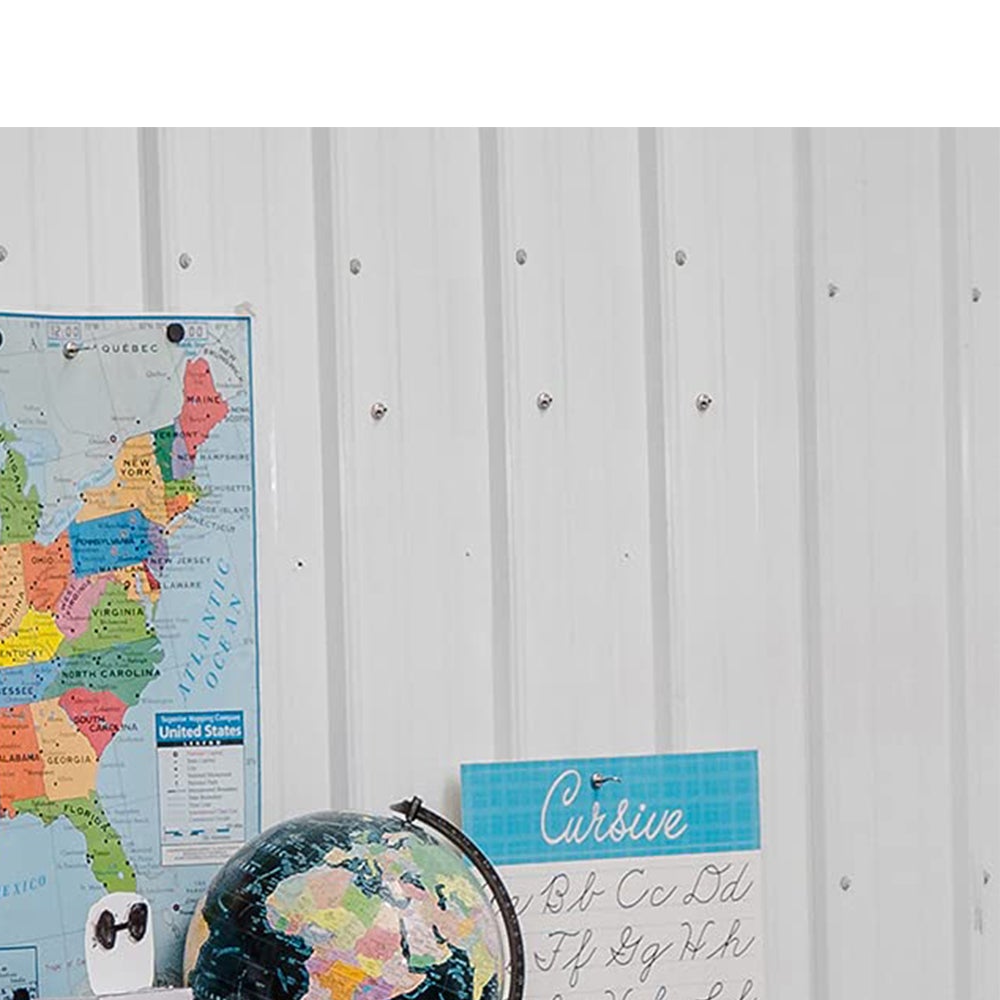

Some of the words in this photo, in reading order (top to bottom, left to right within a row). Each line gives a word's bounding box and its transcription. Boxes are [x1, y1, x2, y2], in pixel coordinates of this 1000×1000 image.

[187, 396, 221, 404] MAINE
[123, 459, 150, 468] NEW
[121, 468, 152, 476] YORK
[31, 556, 54, 565] OHIO
[177, 556, 211, 564] JERSEY
[91, 607, 144, 617] VIRGINIA
[62, 668, 97, 678] NORTH
[100, 669, 161, 678] CAROLINA
[74, 715, 106, 725] SOUTH
[89, 723, 138, 733] CAROLINA
[159, 724, 202, 739] United
[204, 723, 242, 738] States
[47, 755, 92, 764] GEORGIA
[540, 768, 688, 845] Cursive
[63, 804, 110, 833] FLORIDA
[541, 871, 605, 915] Bb
[616, 868, 678, 909] Cc
[682, 862, 754, 905] Dd
